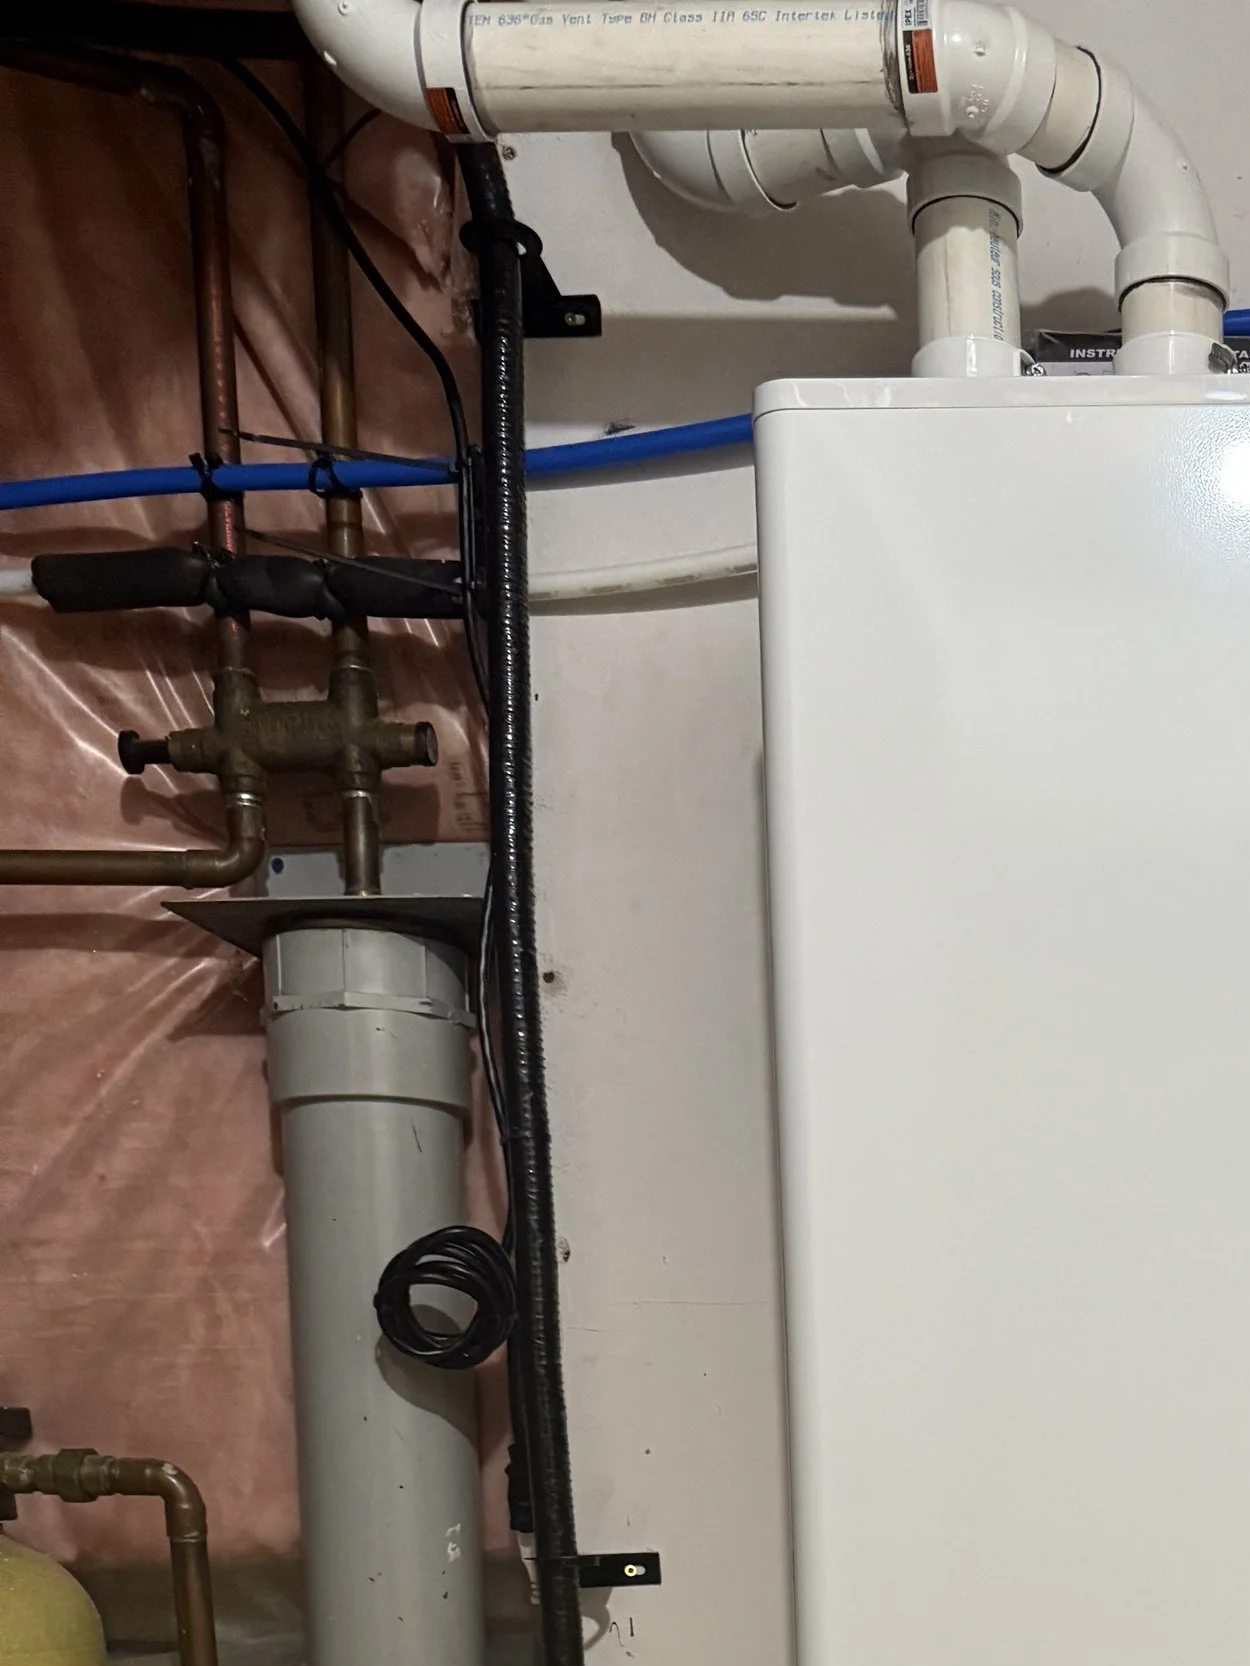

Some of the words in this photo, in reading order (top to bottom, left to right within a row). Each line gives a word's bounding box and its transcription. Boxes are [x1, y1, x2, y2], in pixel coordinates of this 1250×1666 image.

[563, 12, 592, 25] Vent
[602, 12, 633, 26] Type
[664, 11, 703, 24] Class
[742, 10, 767, 23] 65C
[775, 9, 837, 23] Intertek
[904, 9, 912, 26] IPEX
